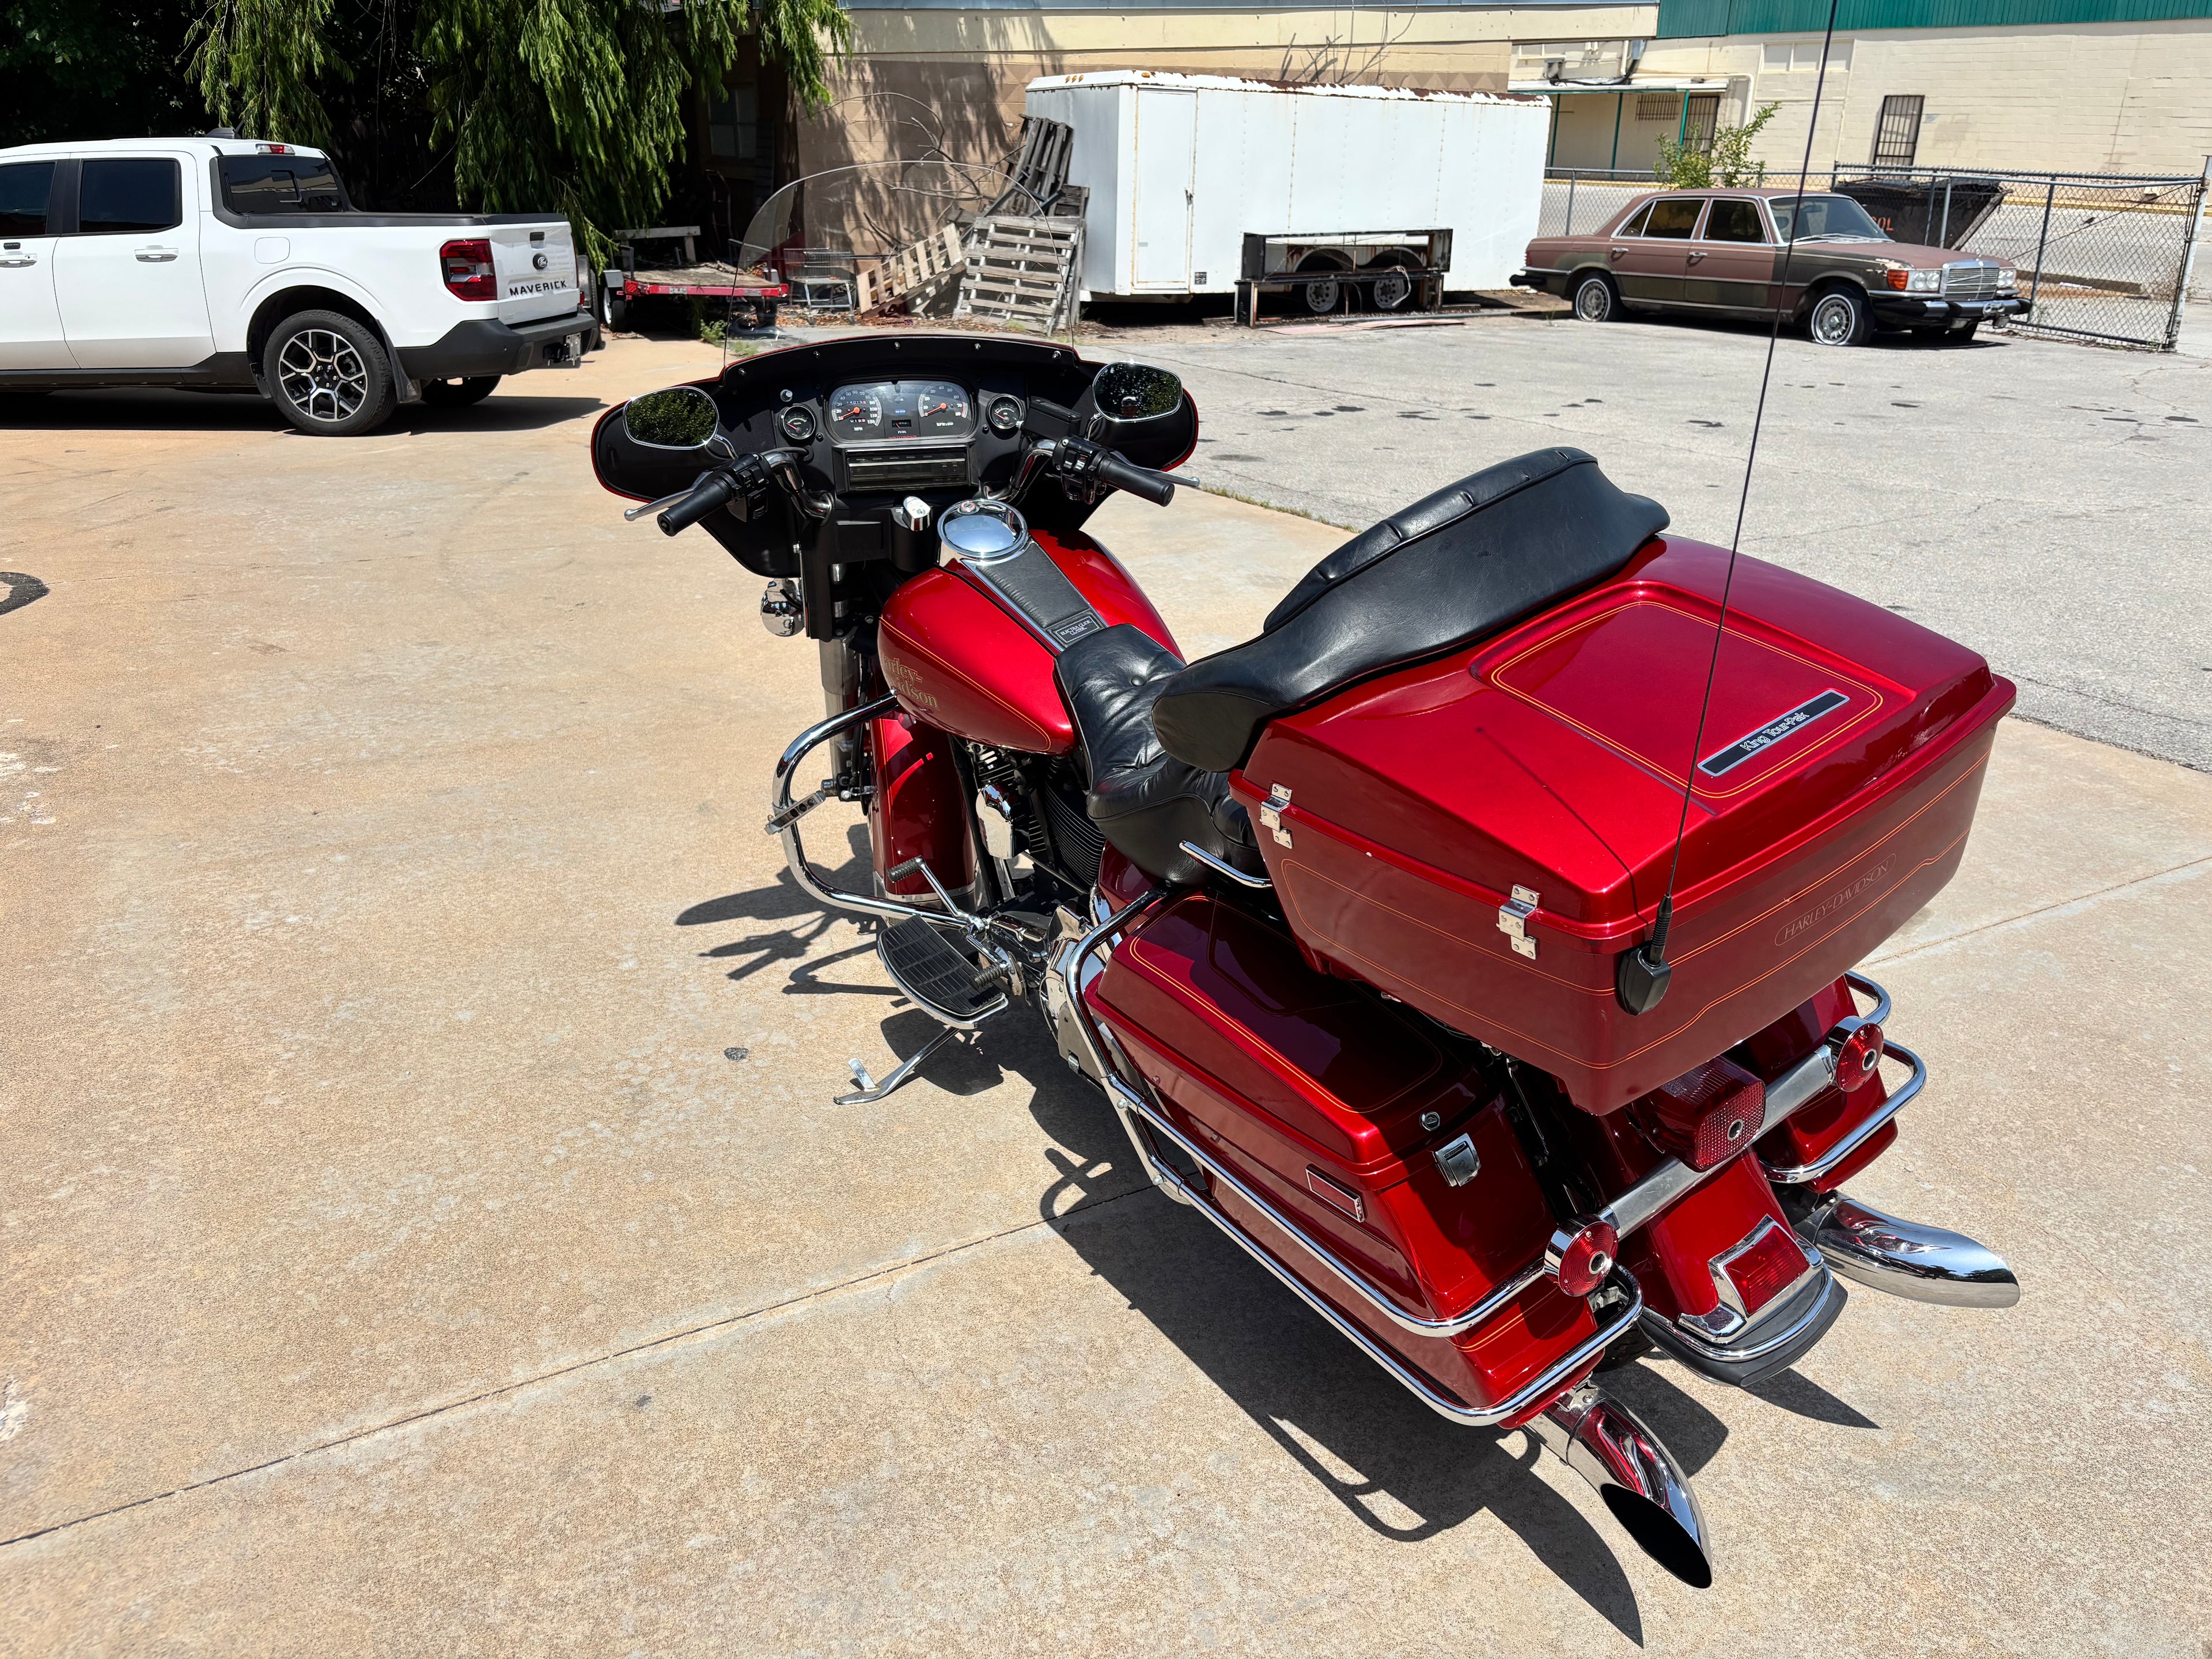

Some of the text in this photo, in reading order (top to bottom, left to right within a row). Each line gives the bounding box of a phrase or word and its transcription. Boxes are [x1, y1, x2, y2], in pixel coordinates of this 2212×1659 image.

[1872, 216, 1894, 231] OL
[509, 280, 567, 296] MAVERICK
[1740, 712, 1810, 751] King Tour-Pak
[1785, 861, 1889, 940] HARLEY-DAVIDSON
